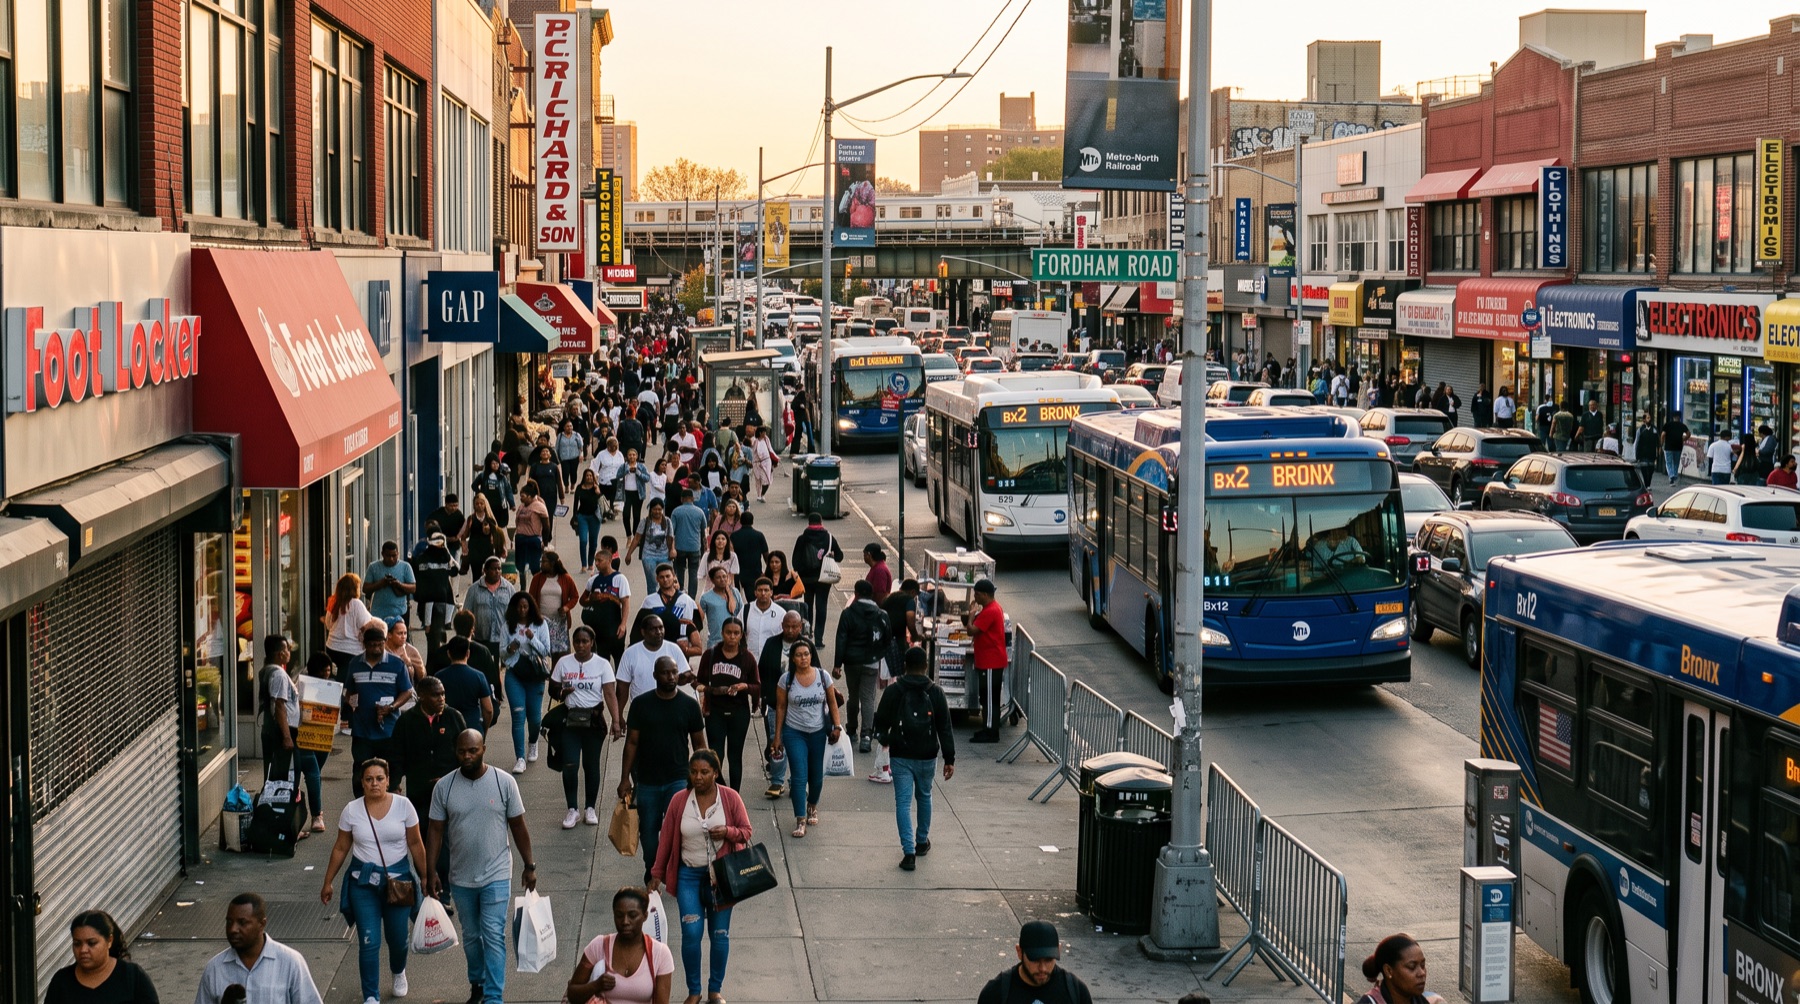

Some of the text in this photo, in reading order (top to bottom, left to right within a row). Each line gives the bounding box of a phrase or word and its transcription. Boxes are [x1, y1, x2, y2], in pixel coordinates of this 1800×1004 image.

[1106, 152, 1159, 162] Metro-North
[1106, 162, 1141, 171] Railroad
[1548, 171, 1562, 264] CLOTHINGS
[540, 226, 575, 243] SON
[1038, 253, 1172, 277] FORDHAM ROAD
[441, 290, 485, 323] GAP
[1649, 301, 1758, 342] ELECTRONICS
[26, 298, 202, 413] Foot Locker
[278, 314, 376, 392] Foot Locker
[1040, 405, 1080, 420] BRONX
[1272, 463, 1335, 487] BRONX
[1203, 601, 1229, 611] Bx12
[1735, 948, 1785, 1004] BRONX
